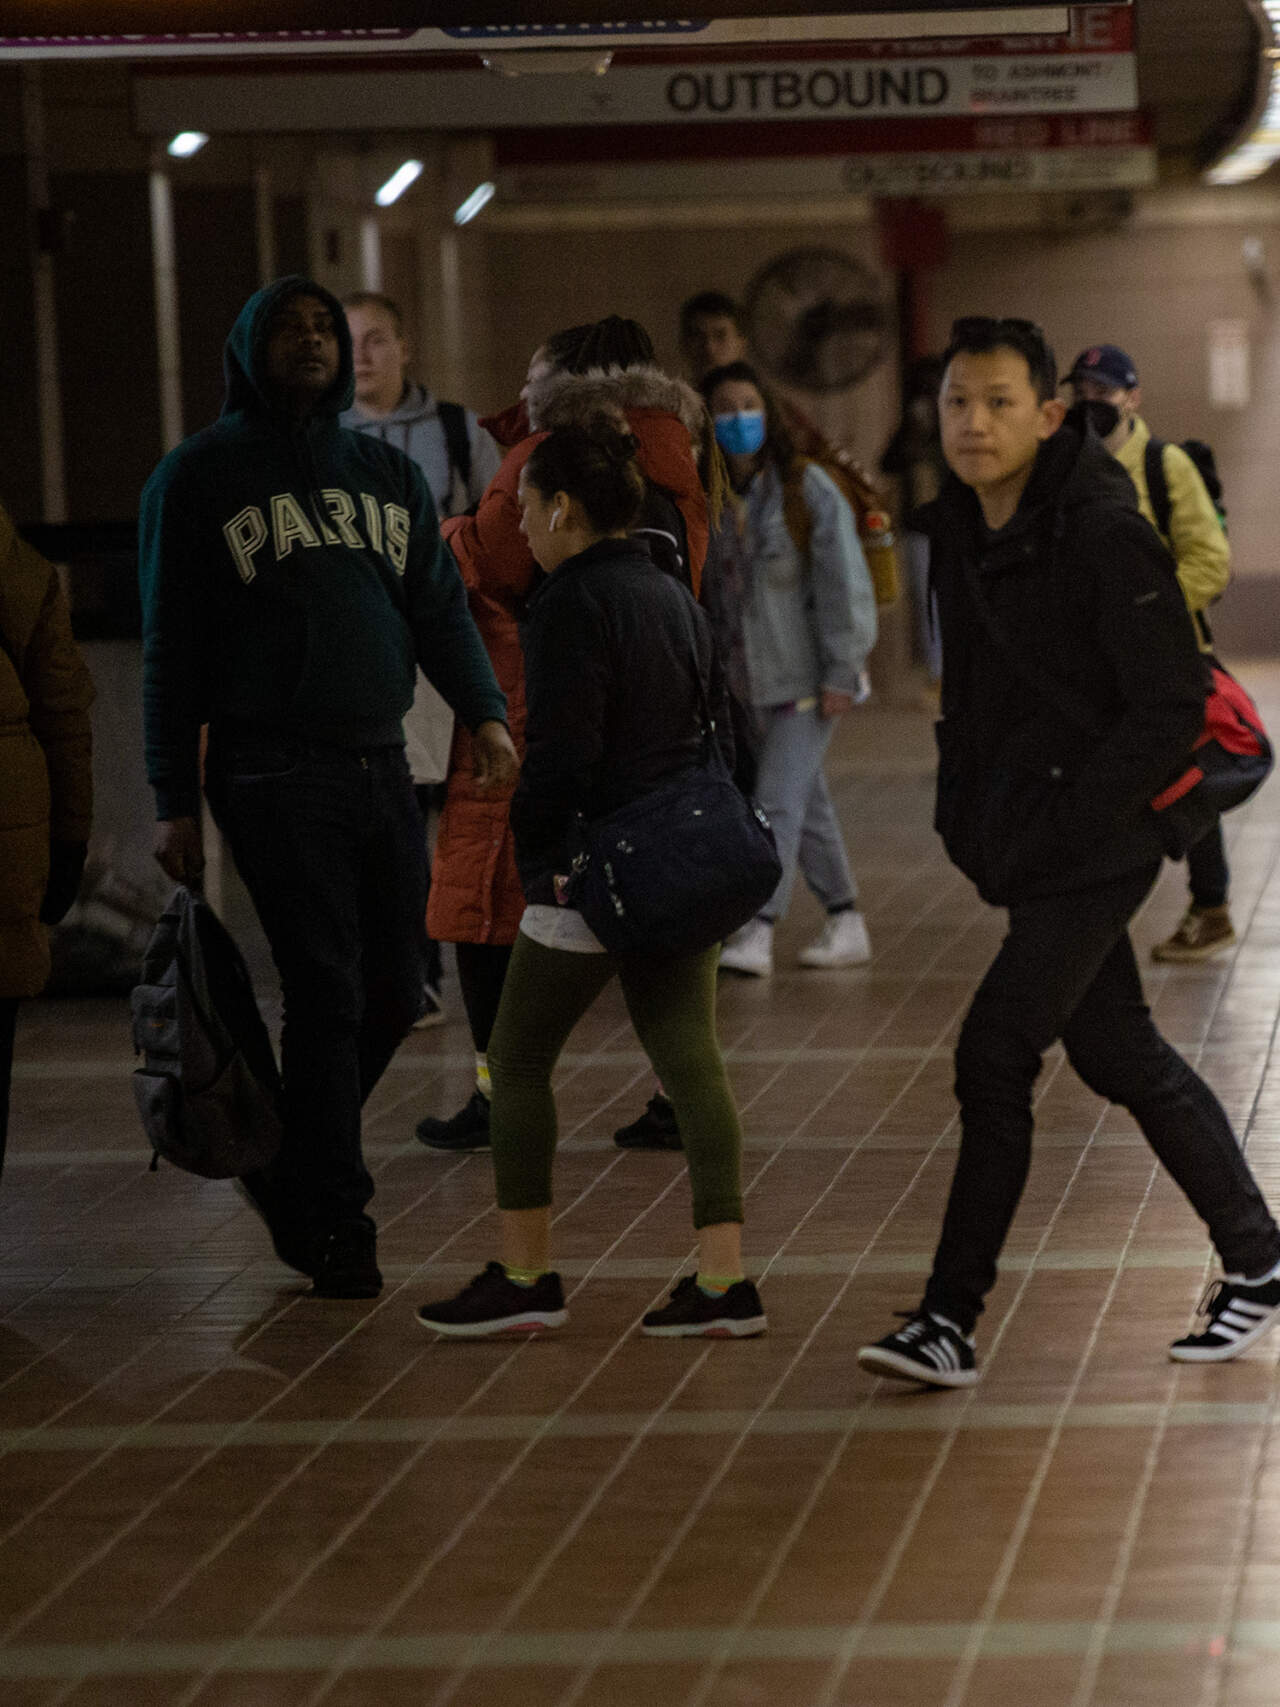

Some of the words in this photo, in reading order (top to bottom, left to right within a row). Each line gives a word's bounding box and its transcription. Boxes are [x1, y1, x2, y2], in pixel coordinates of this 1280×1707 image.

[666, 67, 949, 111] OUTBOUND
[971, 64, 1000, 82] TO
[222, 488, 411, 585] PARIS
